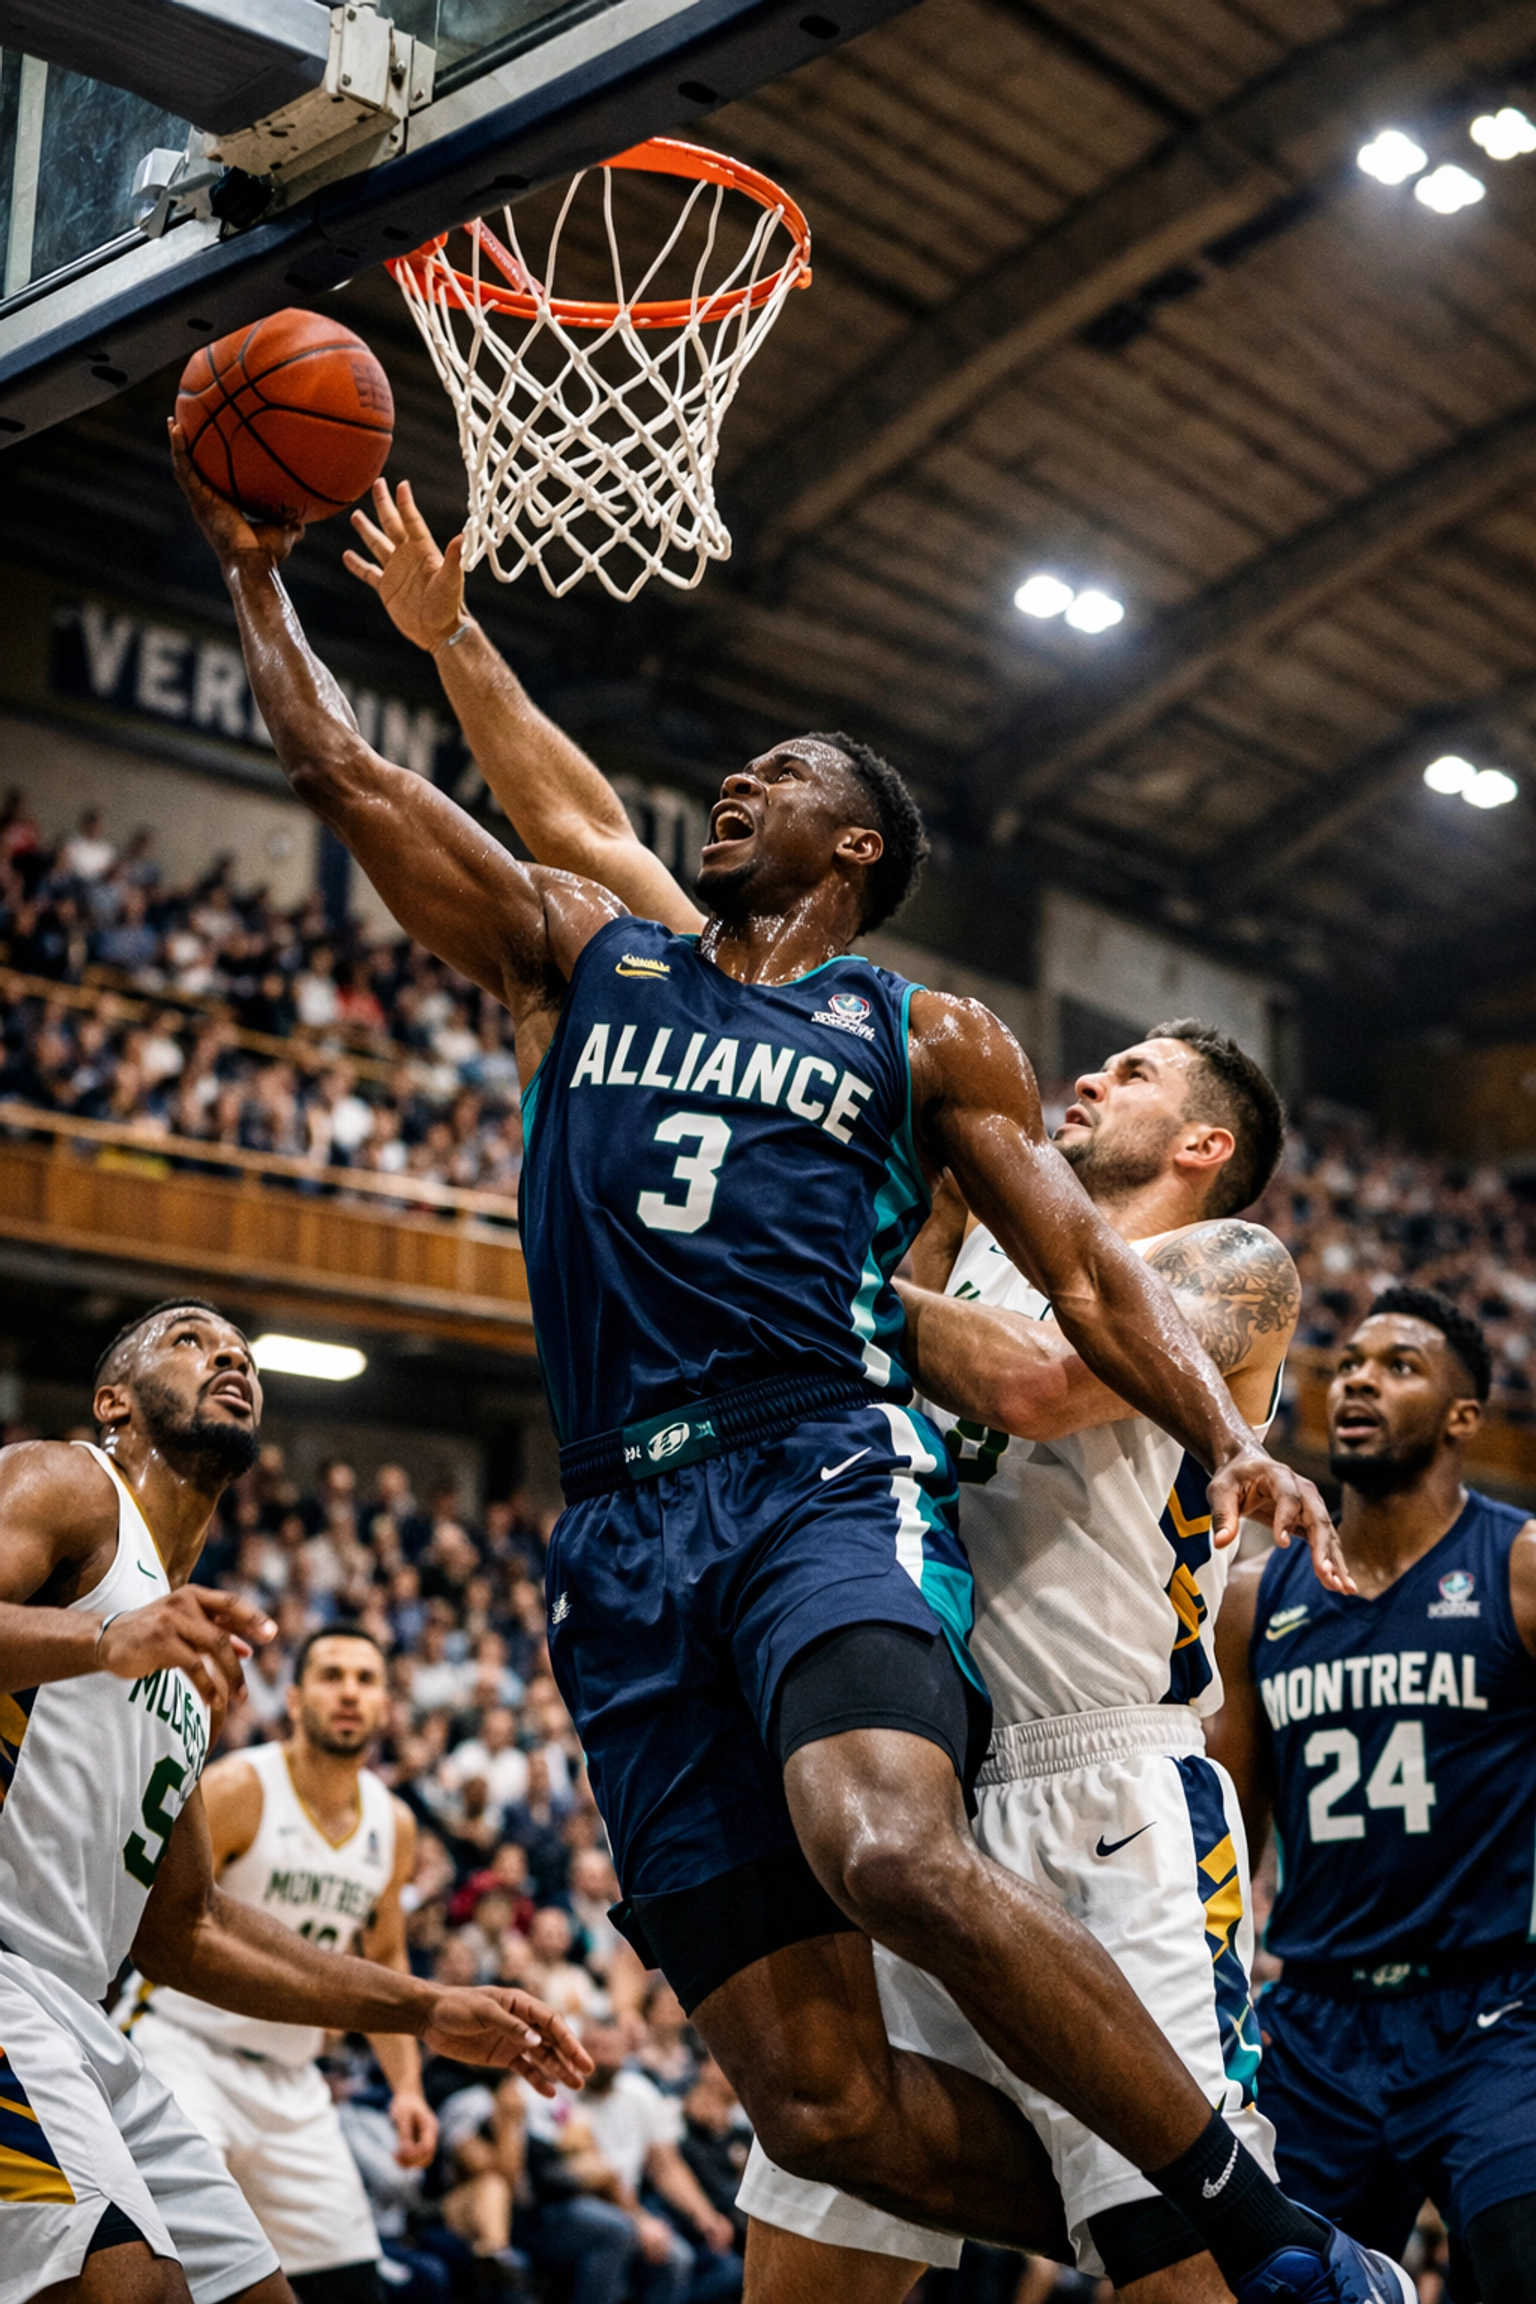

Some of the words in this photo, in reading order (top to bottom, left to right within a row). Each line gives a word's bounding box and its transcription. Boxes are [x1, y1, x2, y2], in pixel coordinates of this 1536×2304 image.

[80, 602, 436, 783] VERN
[569, 1023, 874, 1144] ALLIANCE
[637, 1111, 732, 1234] 3
[1261, 1651, 1487, 1730] MONTREAL
[1304, 1720, 1436, 1843] 24
